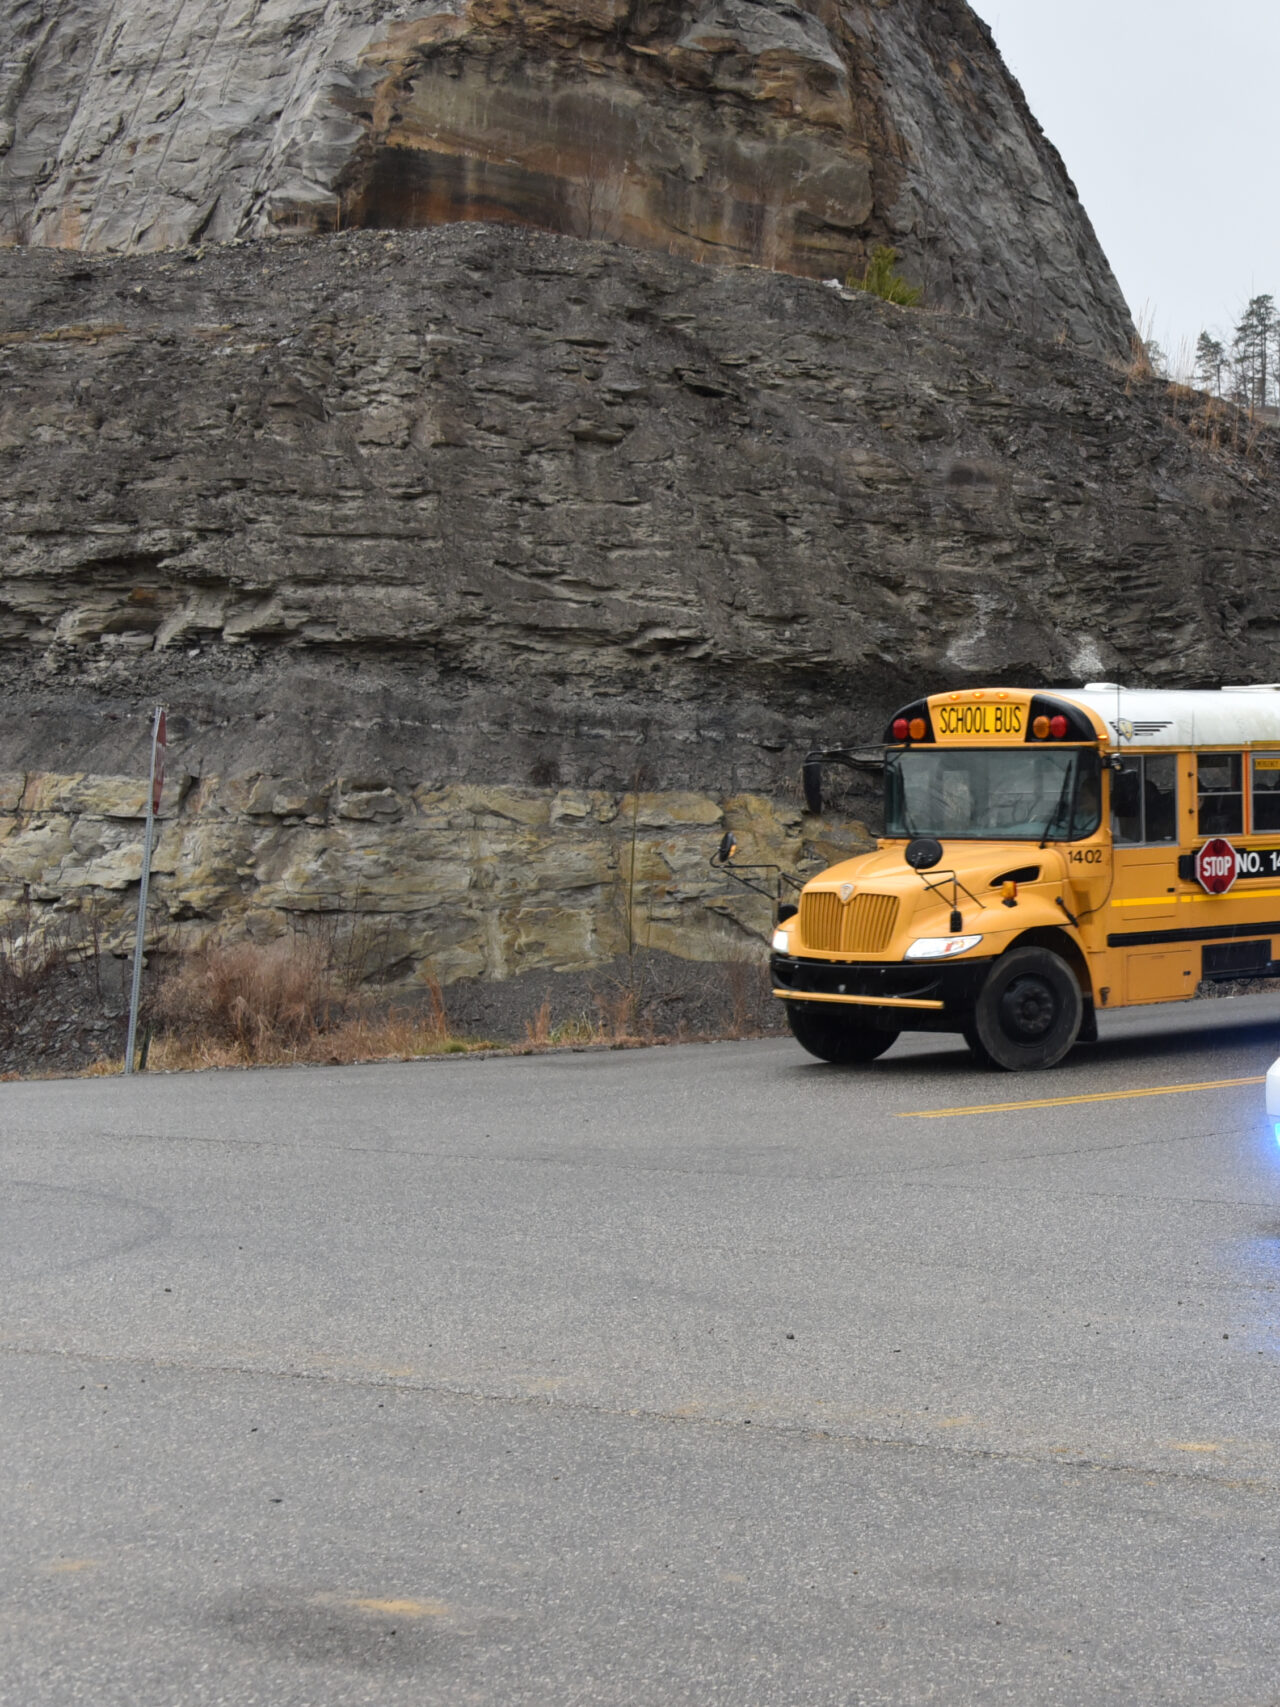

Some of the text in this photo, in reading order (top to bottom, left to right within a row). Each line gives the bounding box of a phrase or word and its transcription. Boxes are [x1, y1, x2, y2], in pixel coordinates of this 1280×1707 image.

[940, 706, 1021, 734] SCHOOL BUS
[1068, 849, 1102, 864] 1402
[1202, 855, 1232, 877] STOP
[1236, 852, 1264, 873] NO.
